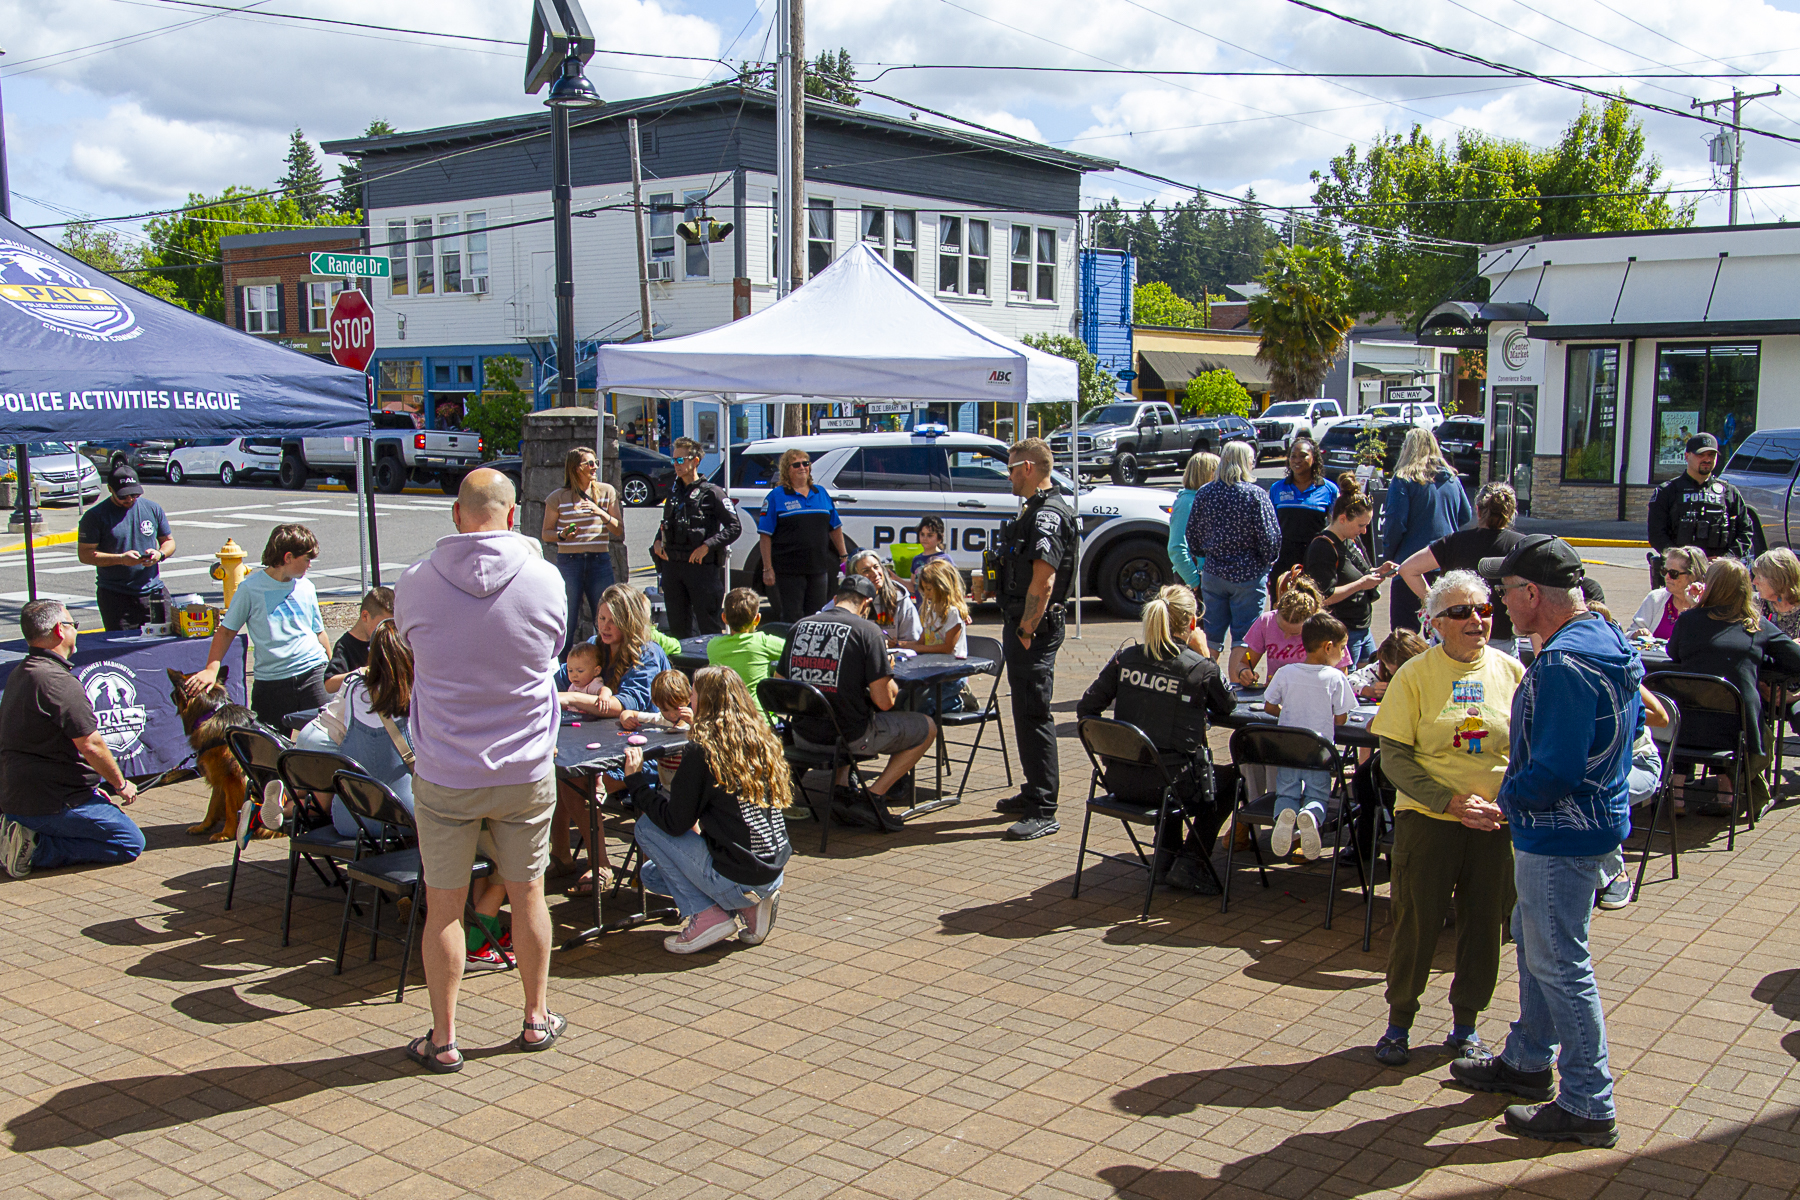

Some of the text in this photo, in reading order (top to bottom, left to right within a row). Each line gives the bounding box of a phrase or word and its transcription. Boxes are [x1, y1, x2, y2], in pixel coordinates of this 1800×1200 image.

[0, 237, 60, 263] ASHINGTON
[328, 256, 383, 275] Randel Dr
[21, 286, 93, 302] PAL
[333, 316, 372, 350] STOP
[1510, 351, 1529, 359] Market
[988, 370, 1012, 382] ABC
[69, 390, 170, 411] ACTIVITIES
[173, 391, 241, 411] LEAGUE
[1391, 391, 1405, 399] ONE
[871, 404, 882, 412] OLDE
[882, 403, 900, 412] LIBRARY
[1664, 418, 1696, 426] SMOOTH
[1683, 492, 1722, 503] POLICE
[1092, 505, 1119, 515] 6L22
[873, 525, 1003, 551] POIC
[798, 623, 848, 638] BERING
[792, 633, 840, 660] SEA
[791, 656, 838, 672] FISHERMAN
[791, 666, 836, 684] 2024
[1120, 667, 1180, 694] POLICE
[99, 709, 131, 726] PAL
